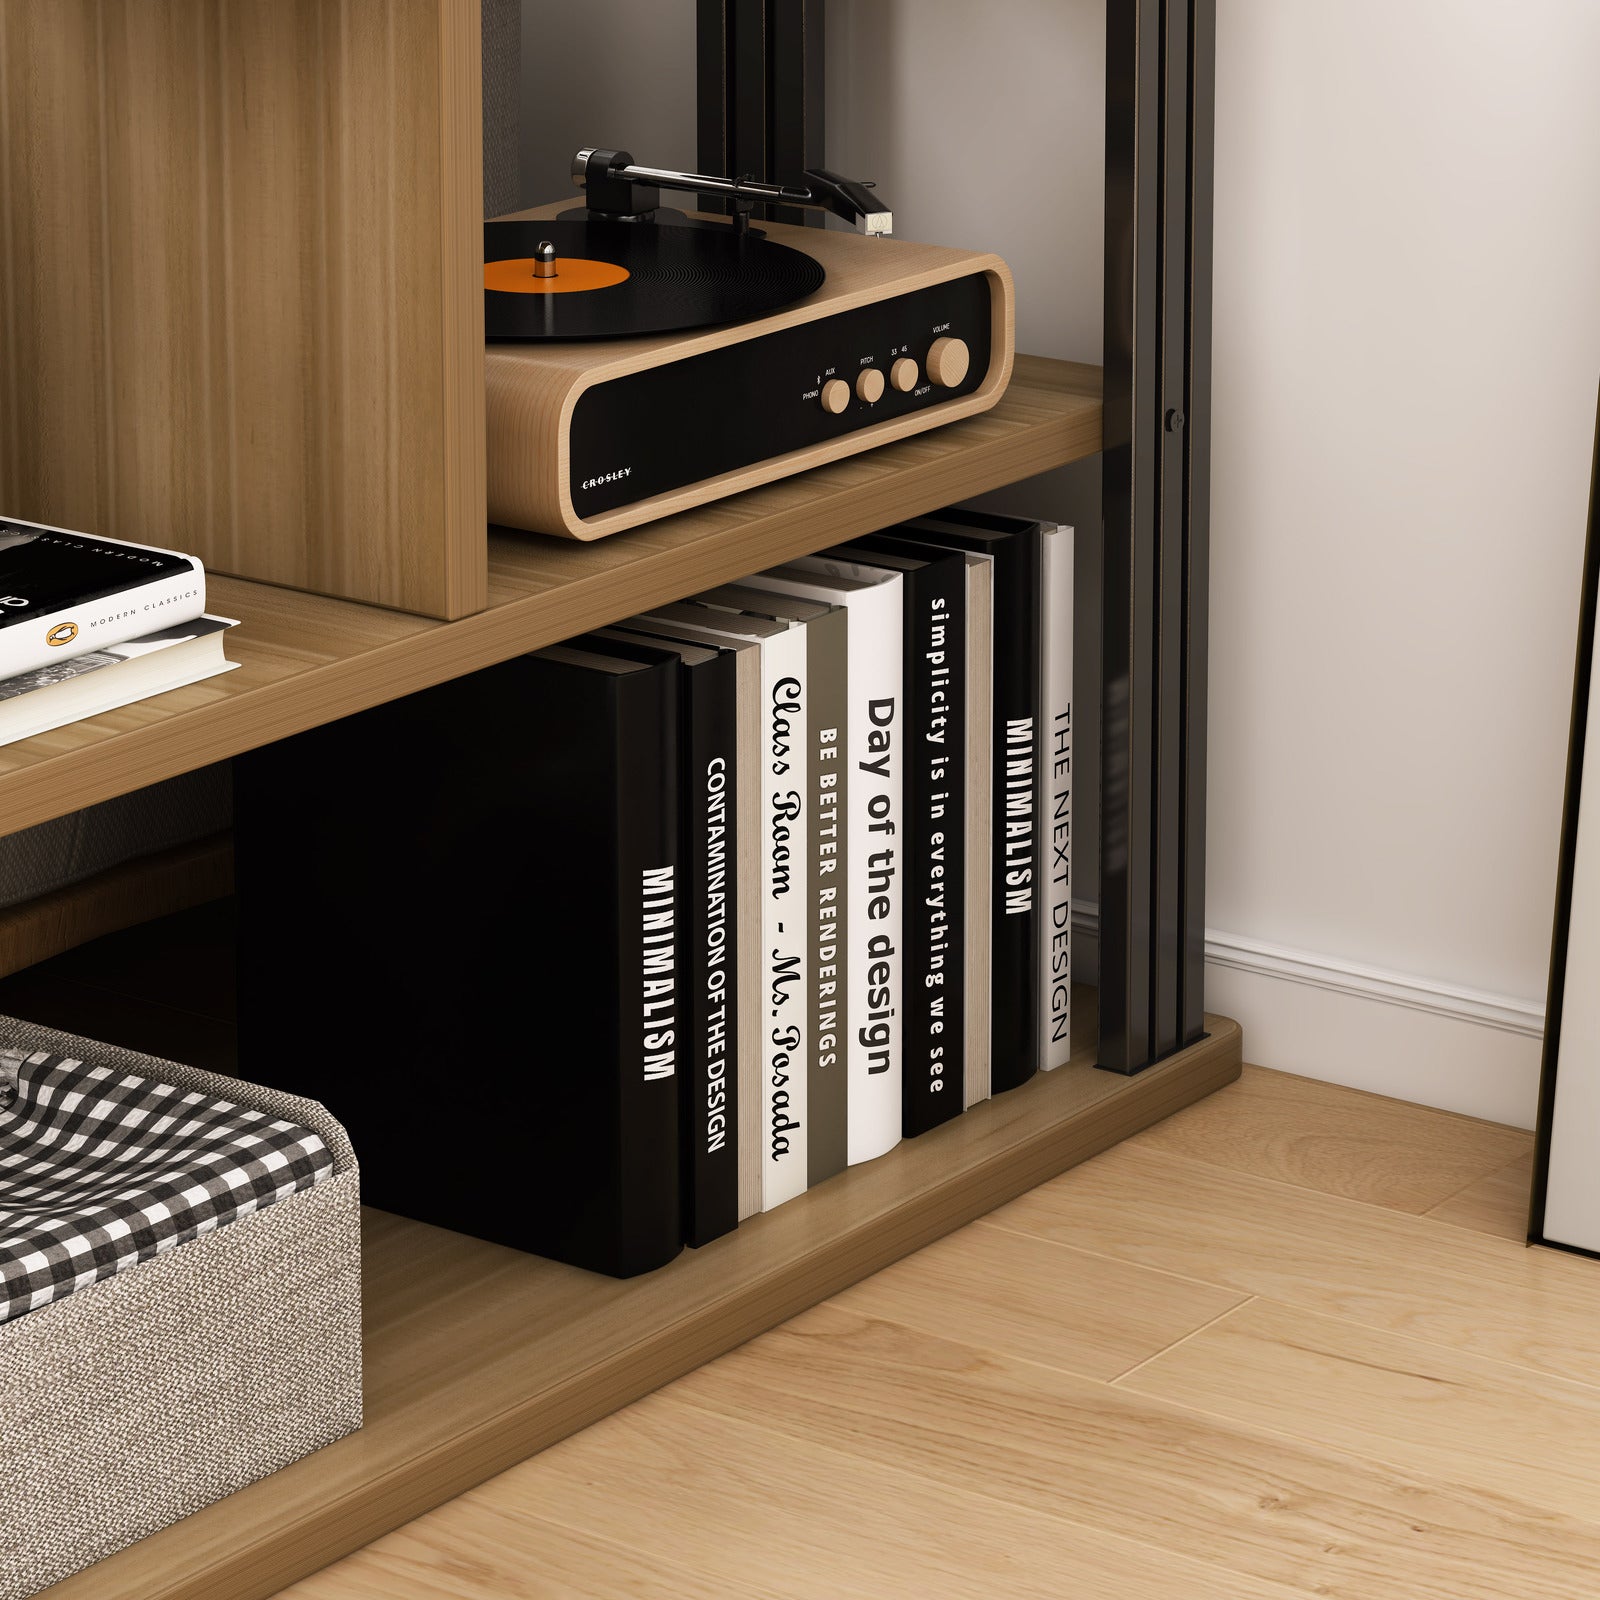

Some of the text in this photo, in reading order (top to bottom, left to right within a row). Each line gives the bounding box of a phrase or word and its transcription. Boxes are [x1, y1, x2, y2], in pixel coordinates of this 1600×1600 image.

[825, 367, 836, 377] AUX
[860, 355, 874, 366] PITCH
[933, 322, 951, 334] VOLUME
[802, 389, 819, 401] PHONO
[914, 385, 931, 397] ON/OFF
[581, 466, 632, 490] CROSLEY
[90, 589, 199, 628] MODERN CLASSICS
[772, 676, 802, 776] Class
[771, 790, 802, 900] Room
[925, 597, 951, 1093] simplicity is in everything we see
[1005, 717, 1033, 915] MINIMALISM
[818, 728, 838, 1068] BE BETTER RENDERINGS
[858, 697, 896, 1075] Day of the design
[1051, 702, 1071, 1043] THE NEXT DESIGN
[642, 865, 676, 1081] MINIMALISM
[707, 757, 726, 1154] CONTAMINATION OF THE DESIGN
[771, 948, 801, 1017] Ms.
[771, 1025, 801, 1162] Posada
